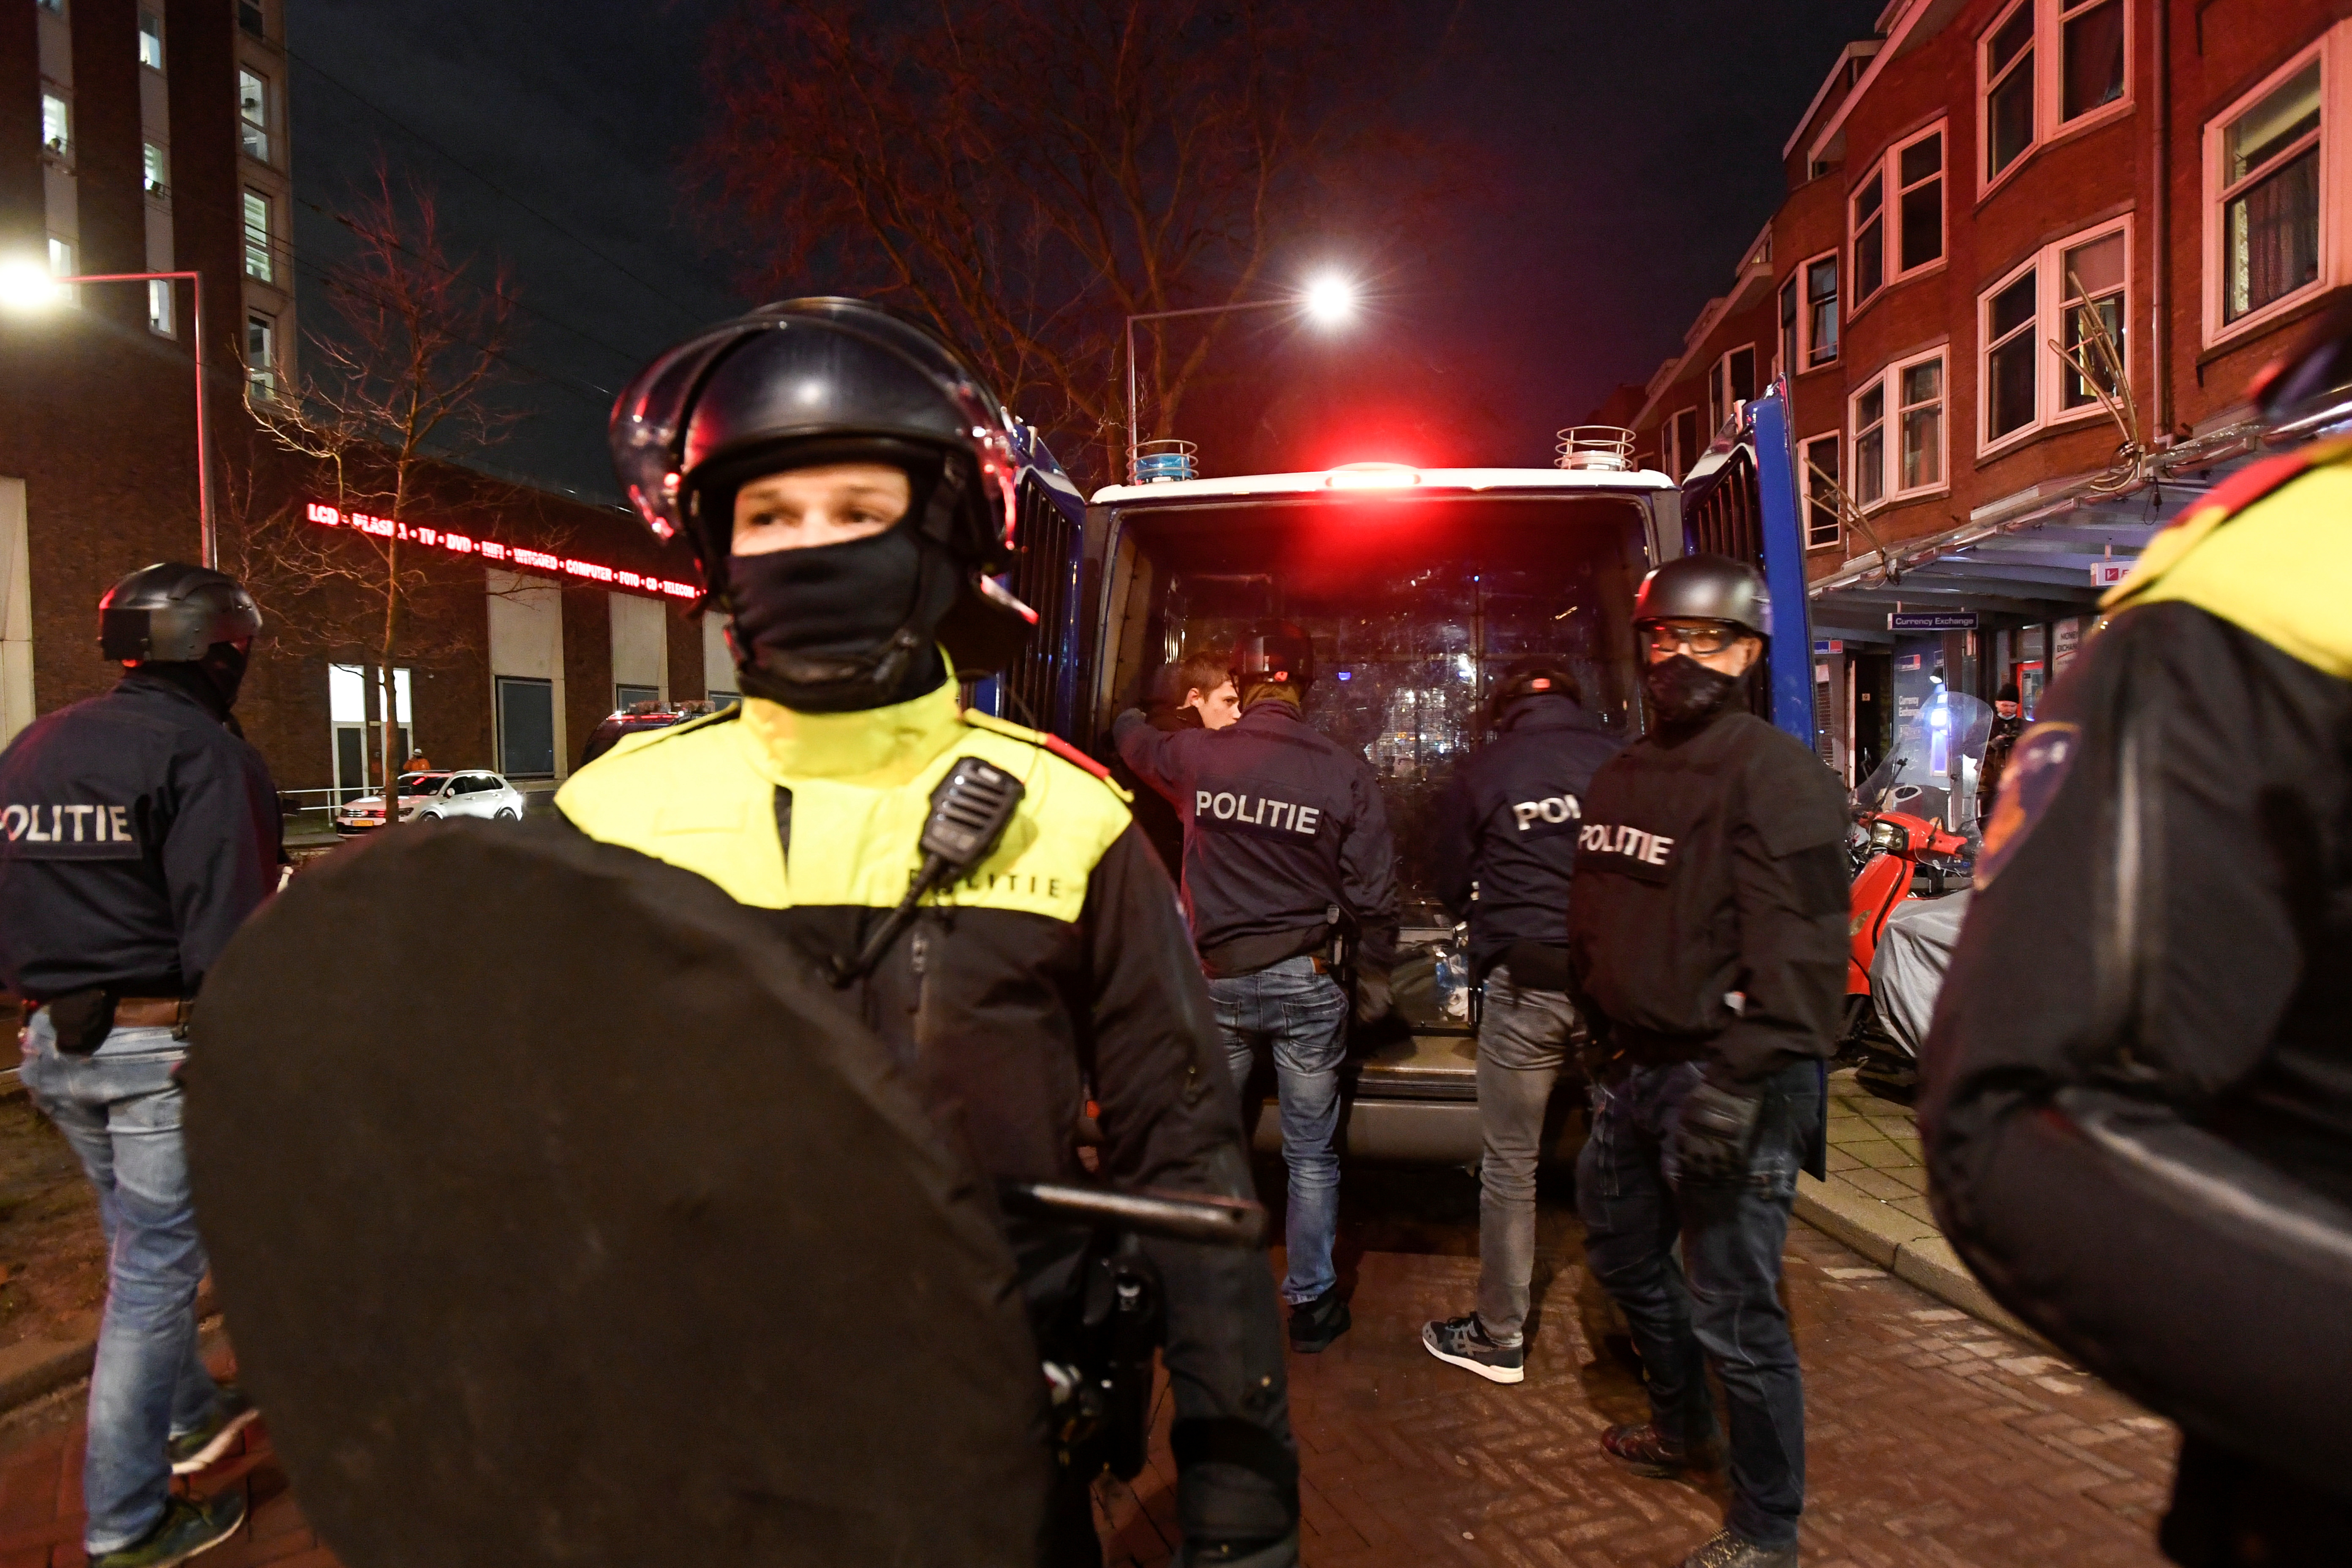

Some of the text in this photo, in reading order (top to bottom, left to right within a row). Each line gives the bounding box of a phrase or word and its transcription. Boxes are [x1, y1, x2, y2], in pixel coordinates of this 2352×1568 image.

[308, 503, 339, 525] LCD
[418, 527, 436, 545] TV
[446, 533, 472, 553] DVD
[513, 548, 558, 570] WITGOED
[565, 559, 612, 582] COMPUTER
[618, 571, 640, 588] FOTO
[645, 577, 658, 591] CD
[663, 580, 696, 599] TELECOM
[1895, 618, 1974, 626] Currency Exchange
[0, 804, 132, 841] OLITIE
[1196, 790, 1319, 834] POLITIE
[1579, 824, 1675, 865] POLITIE
